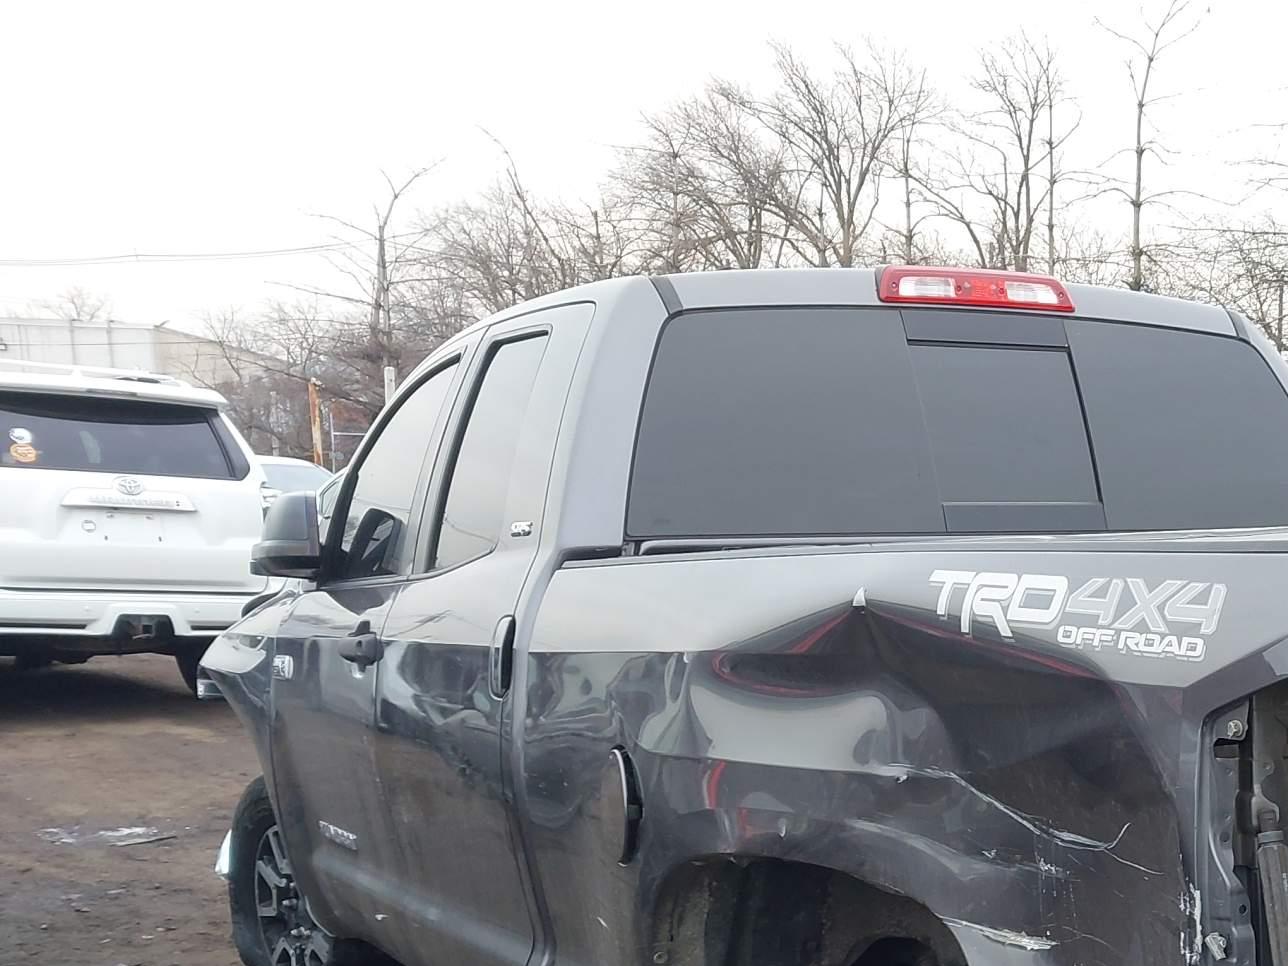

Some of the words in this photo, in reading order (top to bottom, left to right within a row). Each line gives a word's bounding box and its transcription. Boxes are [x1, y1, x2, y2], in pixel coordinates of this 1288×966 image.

[928, 569, 1069, 640] TRD
[1057, 625, 1116, 647] OFF
[1117, 631, 1205, 657] ROAD
